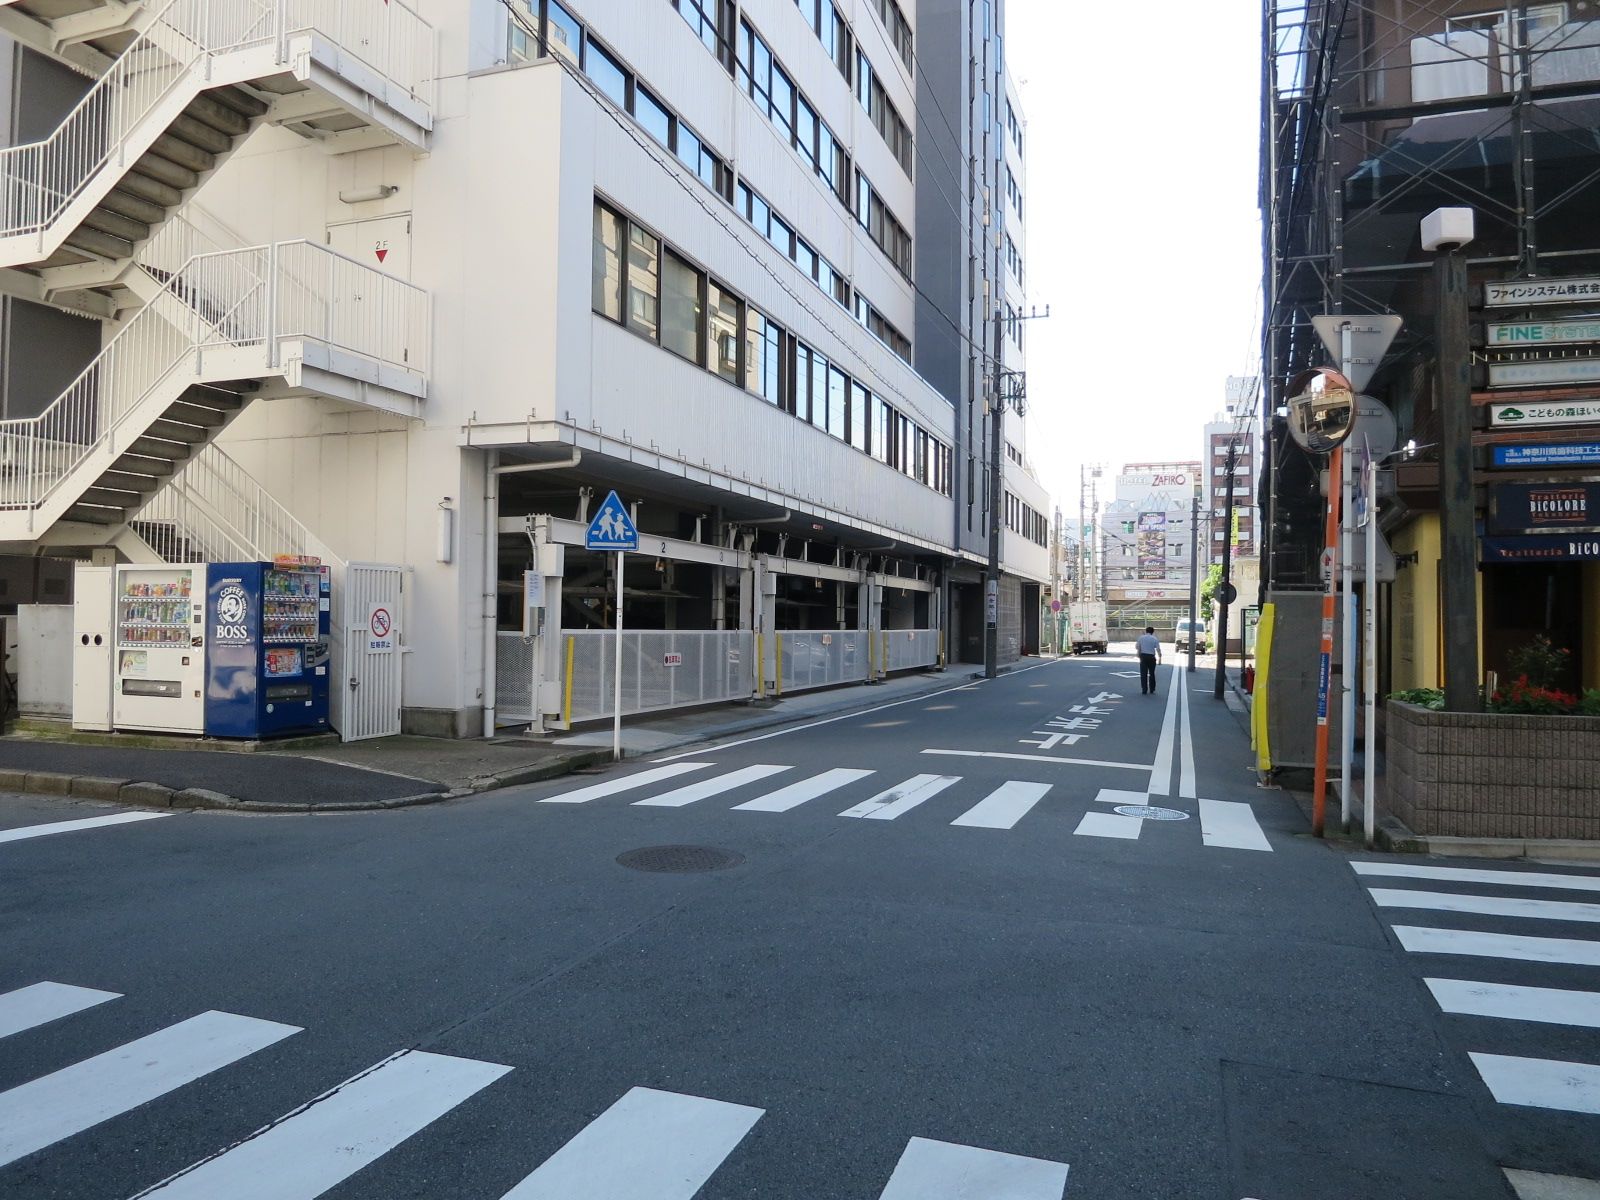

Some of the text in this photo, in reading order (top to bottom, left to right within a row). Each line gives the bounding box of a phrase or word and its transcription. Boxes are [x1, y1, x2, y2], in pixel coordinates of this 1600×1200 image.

[1491, 284, 1600, 299] ファインシステム株式会
[1496, 326, 1543, 342] FINE
[1152, 474, 1186, 486] ZAFIRO
[661, 542, 666, 554] 2
[220, 586, 245, 598] COFFEE
[216, 625, 247, 639] BOSS
